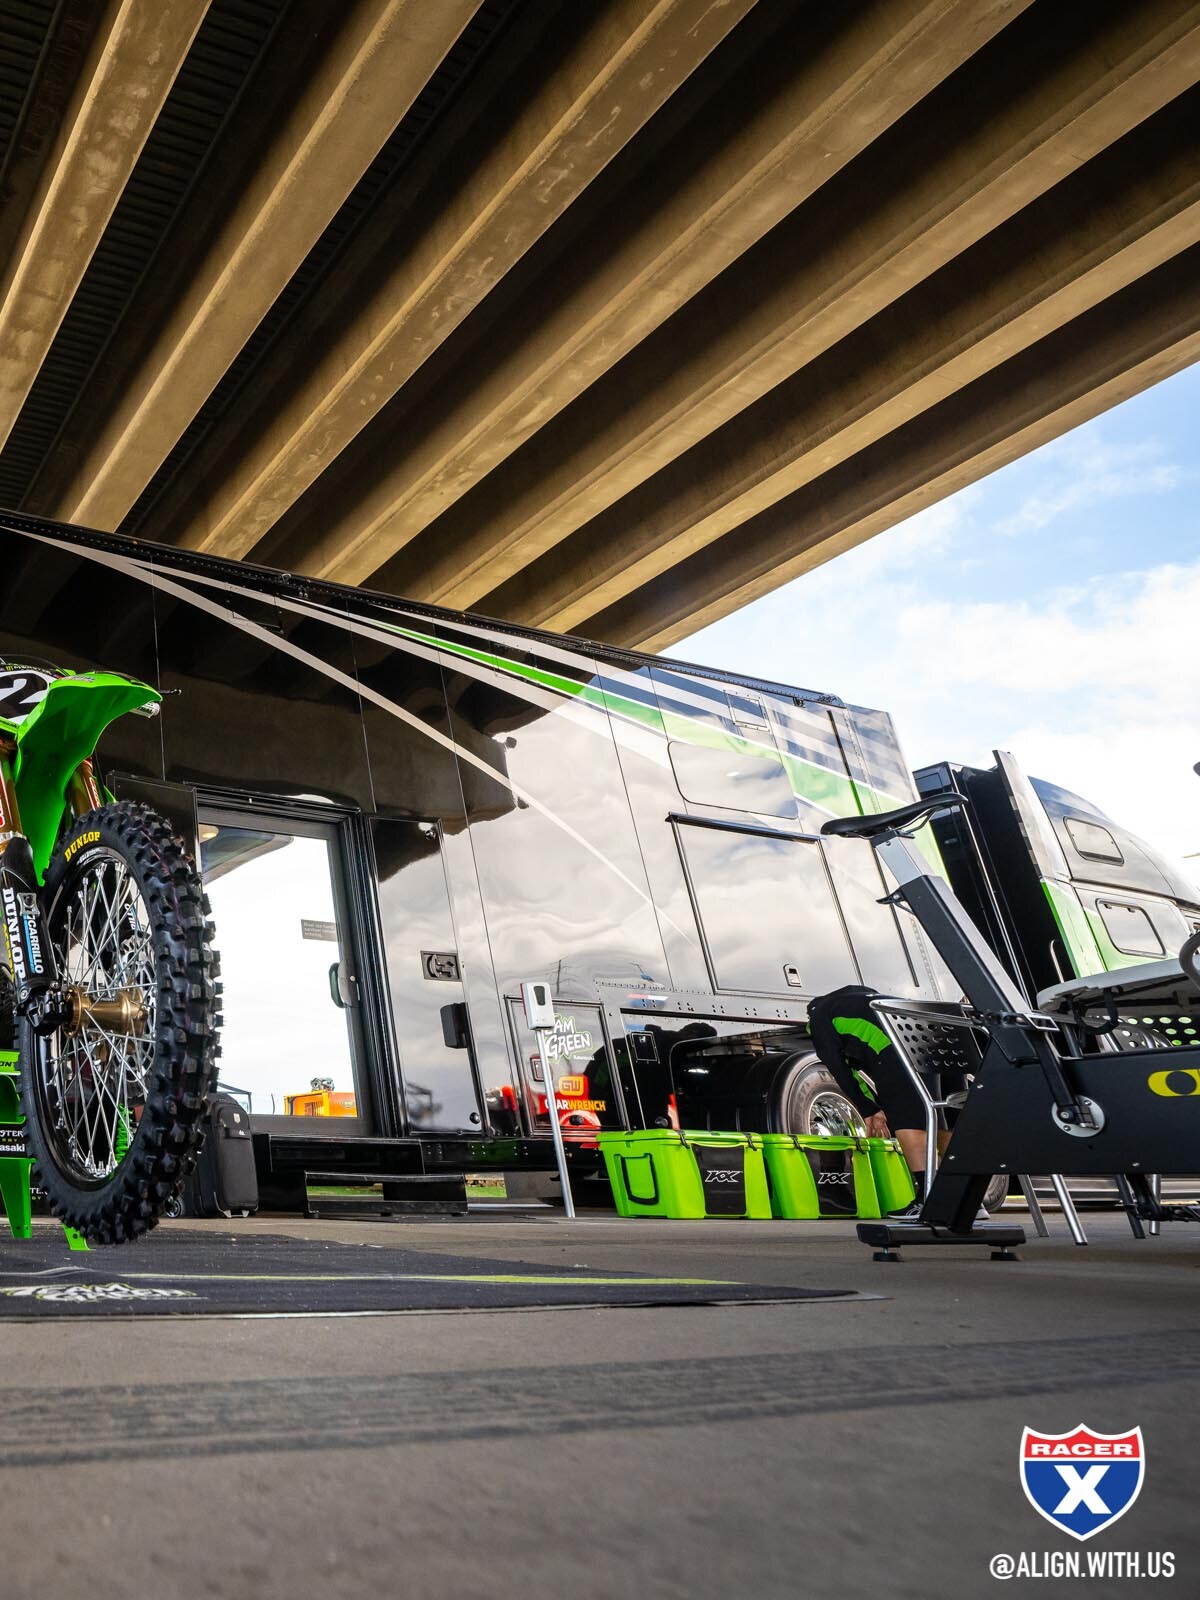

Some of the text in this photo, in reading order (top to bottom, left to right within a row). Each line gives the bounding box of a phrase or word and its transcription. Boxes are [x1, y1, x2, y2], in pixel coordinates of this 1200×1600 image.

[64, 831, 101, 862] DUNLOP
[2, 887, 27, 980] DUNLOP
[545, 1032, 591, 1061] GREEN
